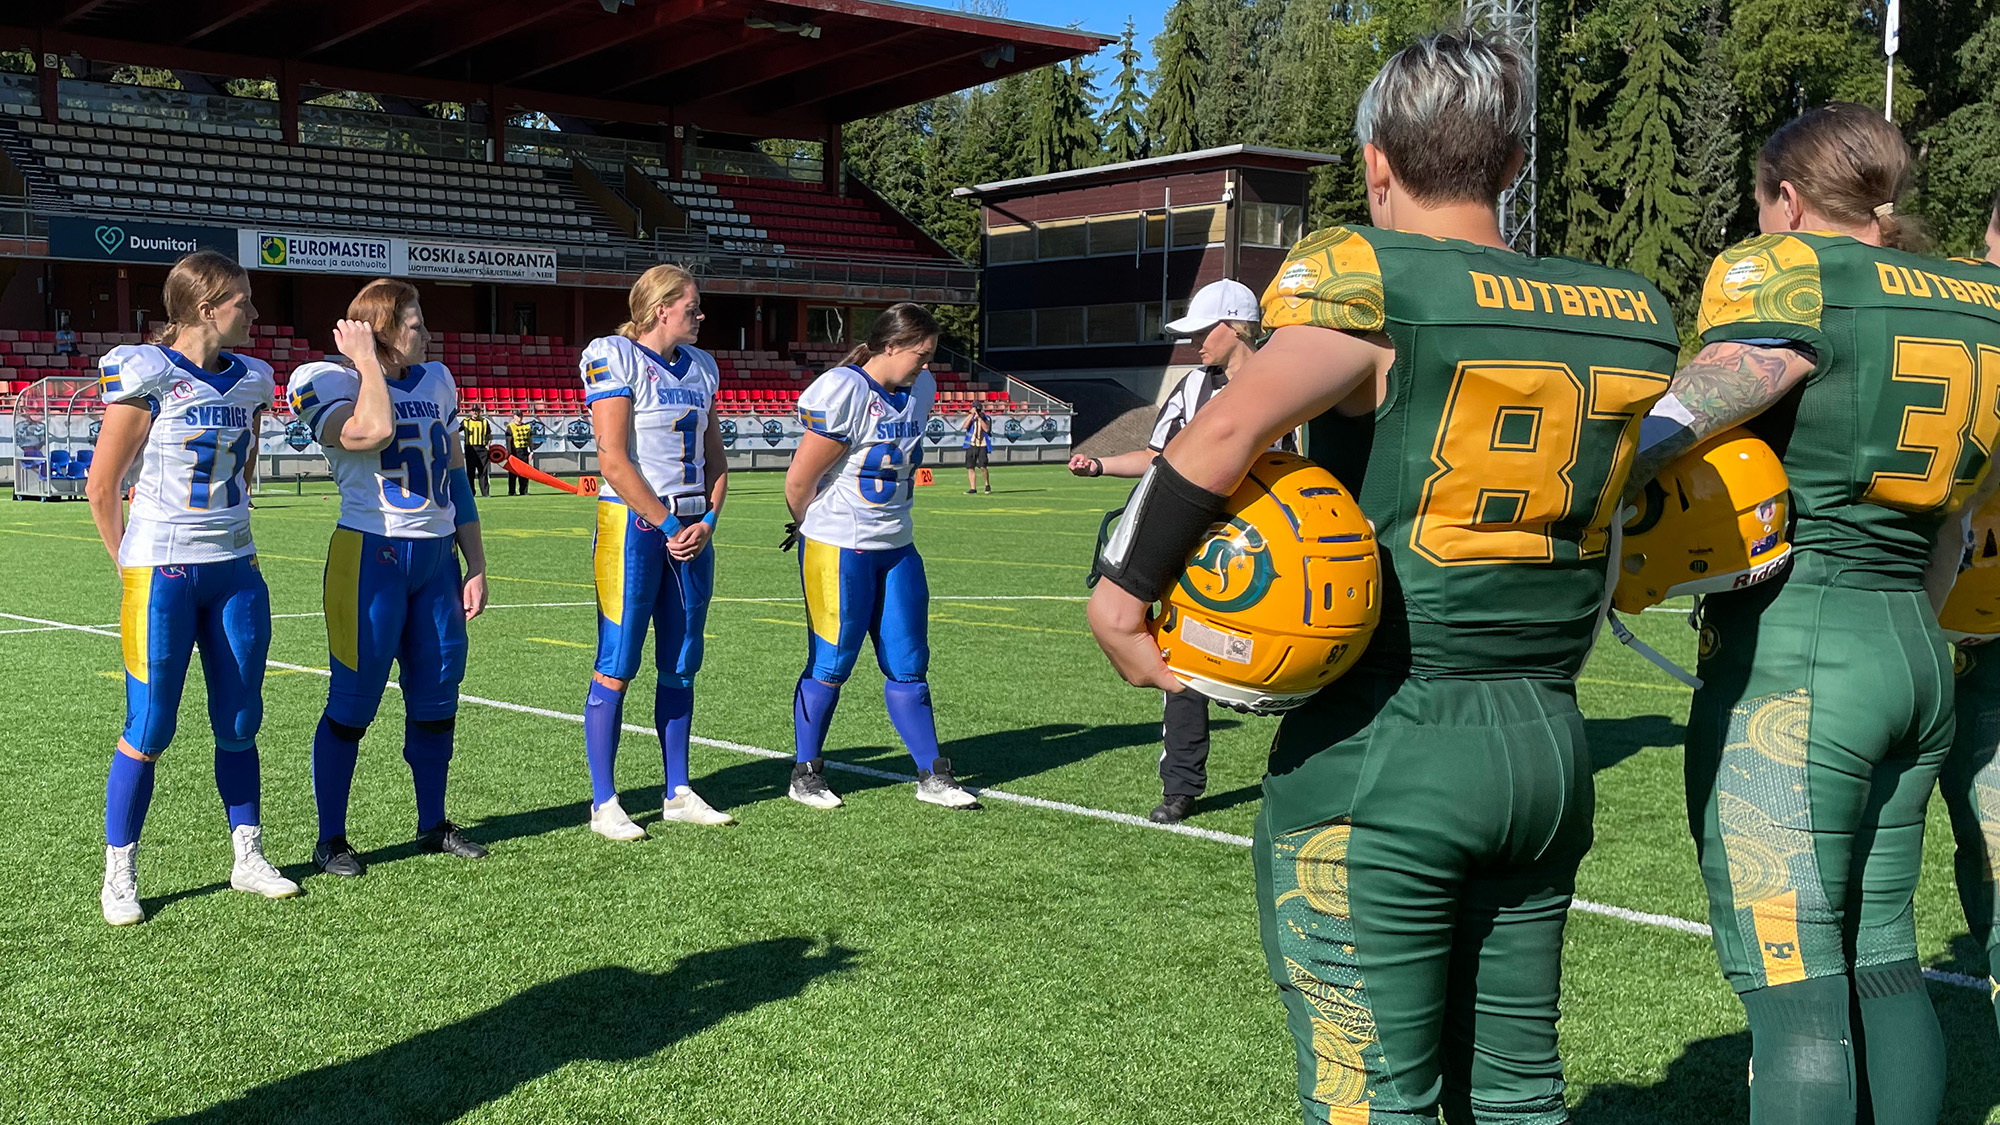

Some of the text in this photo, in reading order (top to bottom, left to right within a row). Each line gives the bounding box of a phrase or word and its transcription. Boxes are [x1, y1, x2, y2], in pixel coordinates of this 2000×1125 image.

[130, 235, 197, 252] Duunitori
[289, 240, 387, 259] EUROMASTER
[289, 256, 387, 269] Renkaat ja autohuolto
[408, 246, 555, 269] KOSKI & SALORANTA
[408, 264, 449, 274] LUOTETTAVAT
[1874, 261, 2000, 312] OUTBAC
[1468, 270, 1658, 325] OUTBACK
[657, 388, 705, 409] SVERIGE
[185, 406, 248, 427] SVERIGE
[672, 408, 699, 486] 1
[183, 428, 251, 511] 11
[380, 421, 452, 512] 58
[1409, 360, 1671, 568] 87
[583, 478, 597, 493] 30
[921, 470, 933, 483] 20
[1326, 643, 1350, 665] 87
